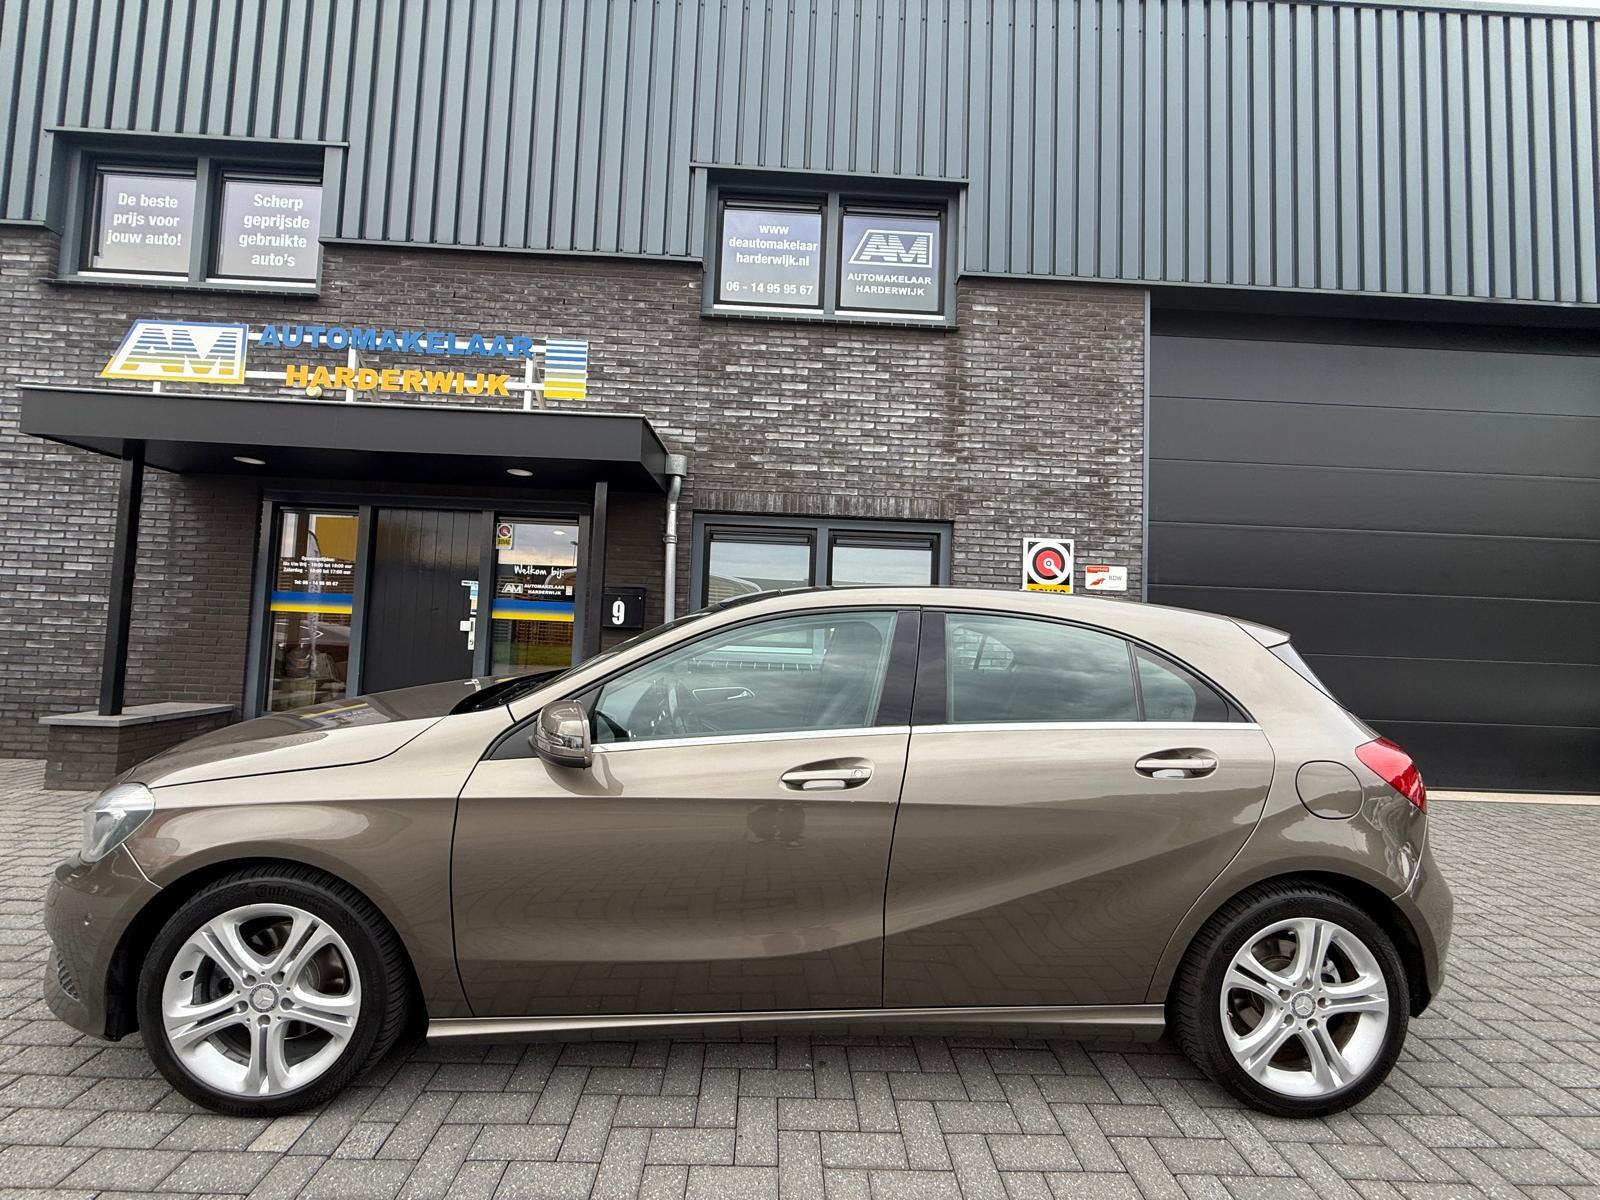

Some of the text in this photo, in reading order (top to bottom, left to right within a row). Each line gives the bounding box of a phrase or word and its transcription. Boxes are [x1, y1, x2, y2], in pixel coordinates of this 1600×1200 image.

[118, 192, 178, 209] De beste
[253, 193, 304, 210] Scherp
[113, 211, 180, 228] prijs voor
[243, 212, 310, 230] geprijsde
[106, 229, 182, 246] jouw auto!
[759, 225, 789, 235] www
[238, 231, 307, 249] gebruikte
[728, 236, 818, 252] deautomakelaar
[858, 233, 929, 264] AM
[736, 252, 810, 267] harderwijk.nl
[847, 272, 932, 286] AUTOMAKELAAR
[726, 281, 740, 292] 06
[751, 282, 764, 293] 14
[766, 283, 781, 294] 95
[783, 284, 797, 295] 95
[799, 284, 814, 296] 67
[855, 285, 925, 297] HARDERWIJK
[258, 324, 534, 360] AUTOMAKELAAR
[117, 326, 240, 377] AM
[285, 364, 511, 397] HARDERWIJK
[514, 563, 547, 576] Welkom
[523, 583, 565, 591] AUTOMAKELAAR
[612, 600, 625, 625] 9
